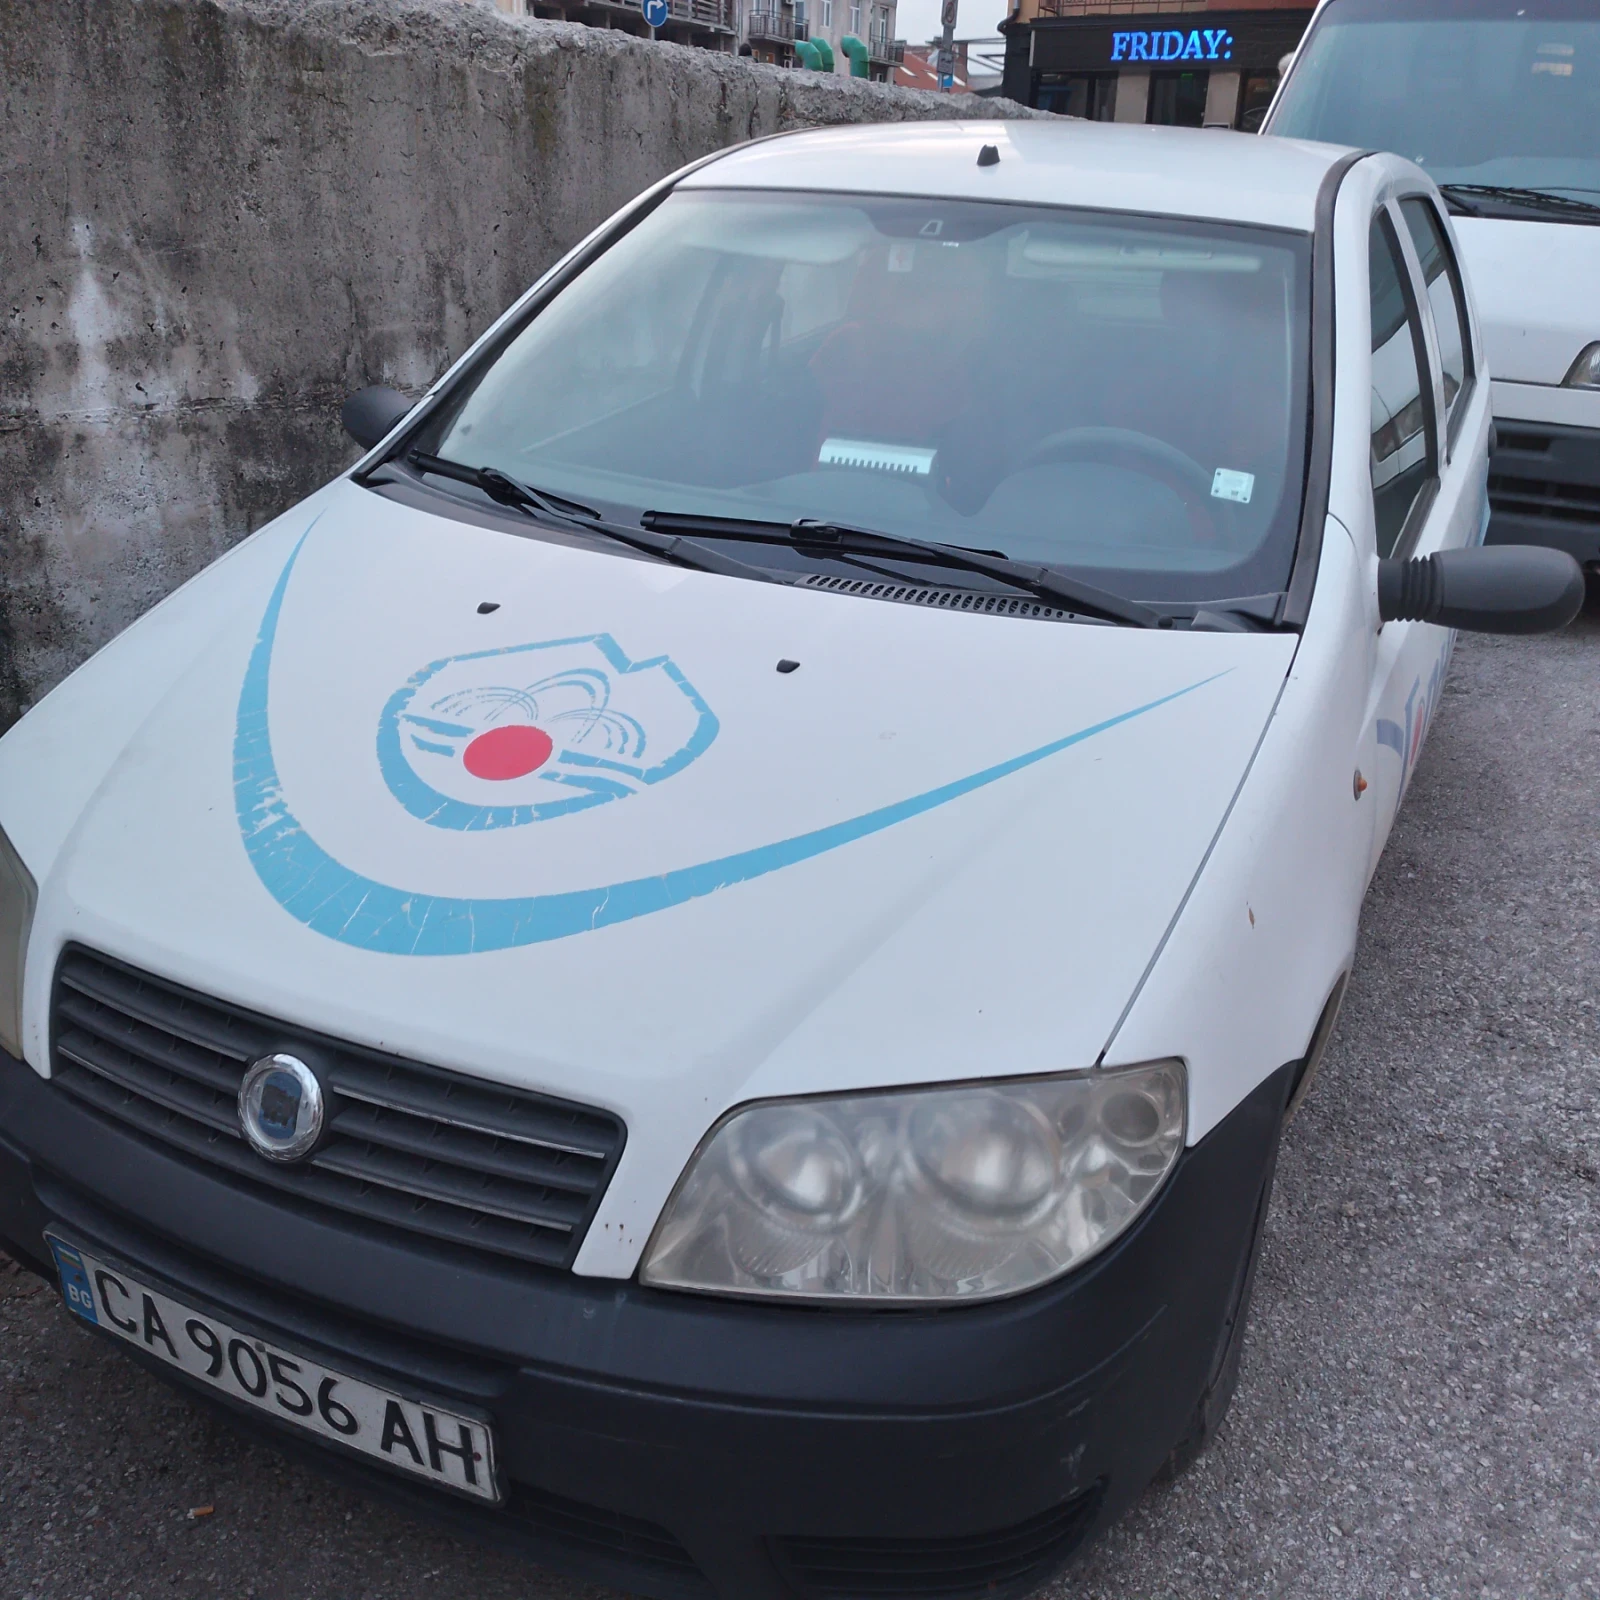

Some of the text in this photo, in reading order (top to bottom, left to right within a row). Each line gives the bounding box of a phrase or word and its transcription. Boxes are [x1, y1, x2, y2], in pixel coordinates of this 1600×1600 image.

[67, 1282, 93, 1309] BG
[94, 1269, 478, 1486] CA 9056 AH
